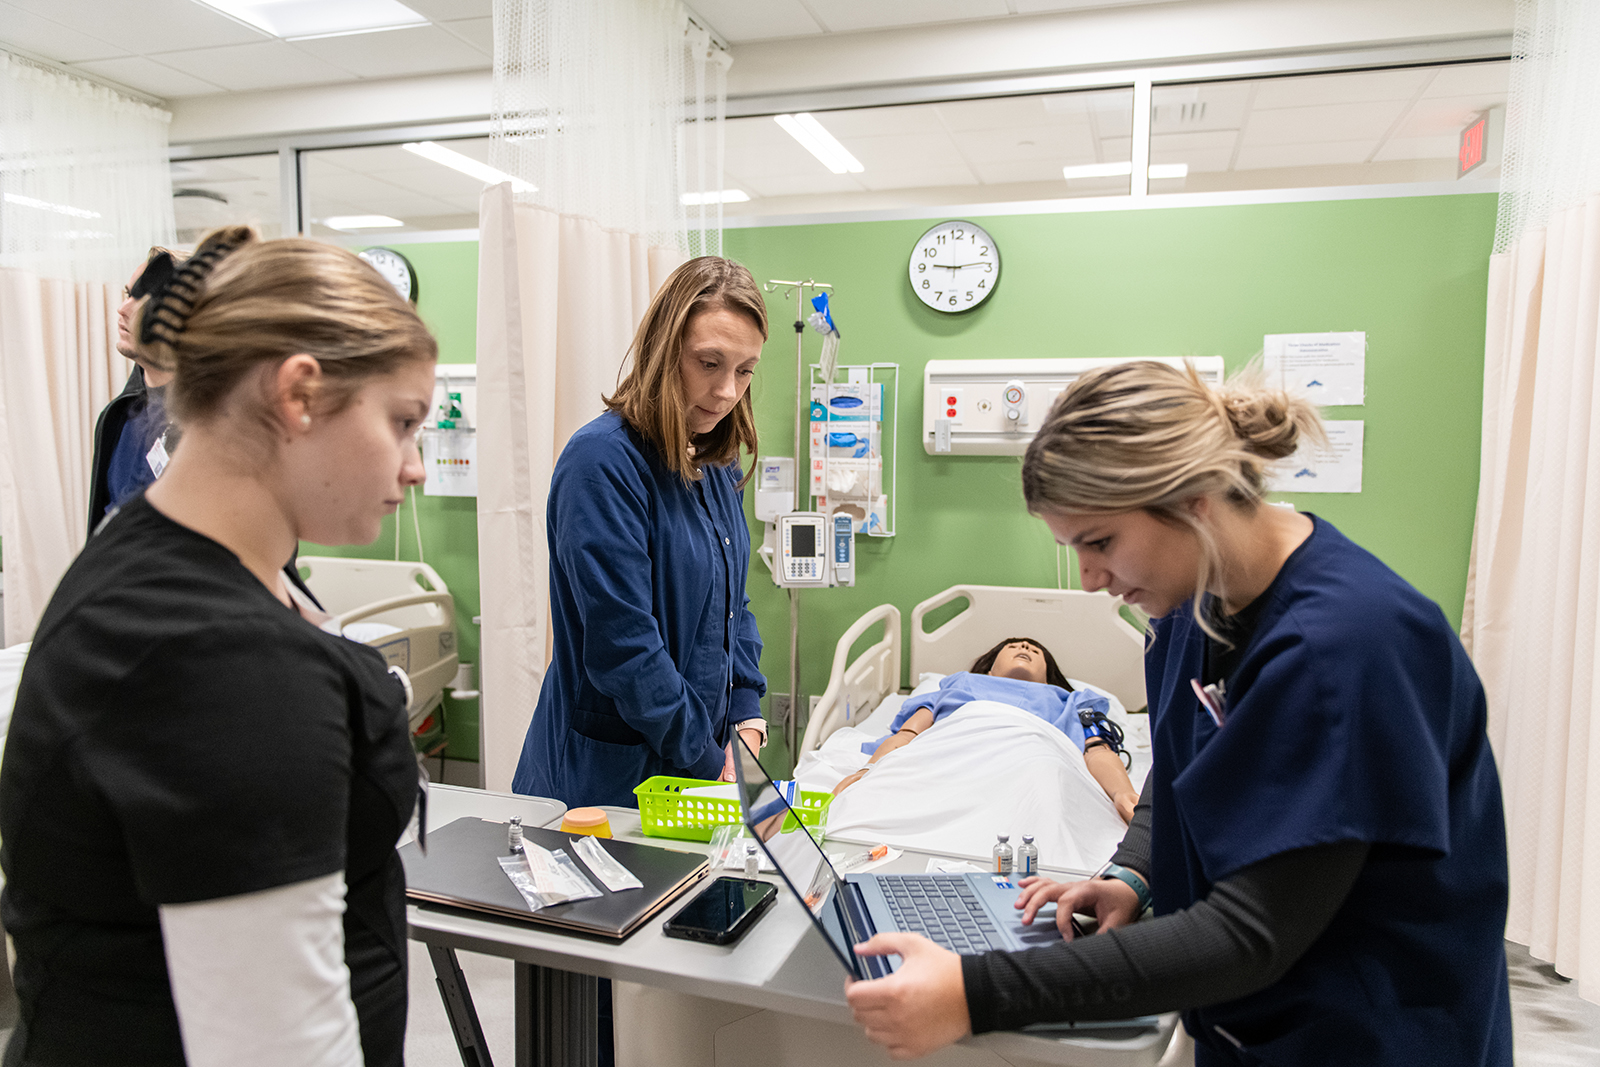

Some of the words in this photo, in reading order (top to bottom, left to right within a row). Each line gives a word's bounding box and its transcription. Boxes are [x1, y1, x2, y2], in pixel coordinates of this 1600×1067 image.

[936, 235, 946, 245] 11
[951, 229, 964, 241] 12
[971, 234, 975, 245] 1
[924, 248, 937, 258] 10
[980, 246, 988, 256] 2
[918, 263, 926, 273] 9
[984, 262, 992, 273] 3
[922, 279, 930, 289] 8
[978, 279, 986, 289] 4
[934, 291, 943, 301] 7
[949, 296, 957, 305] 6
[965, 291, 974, 301] 5
